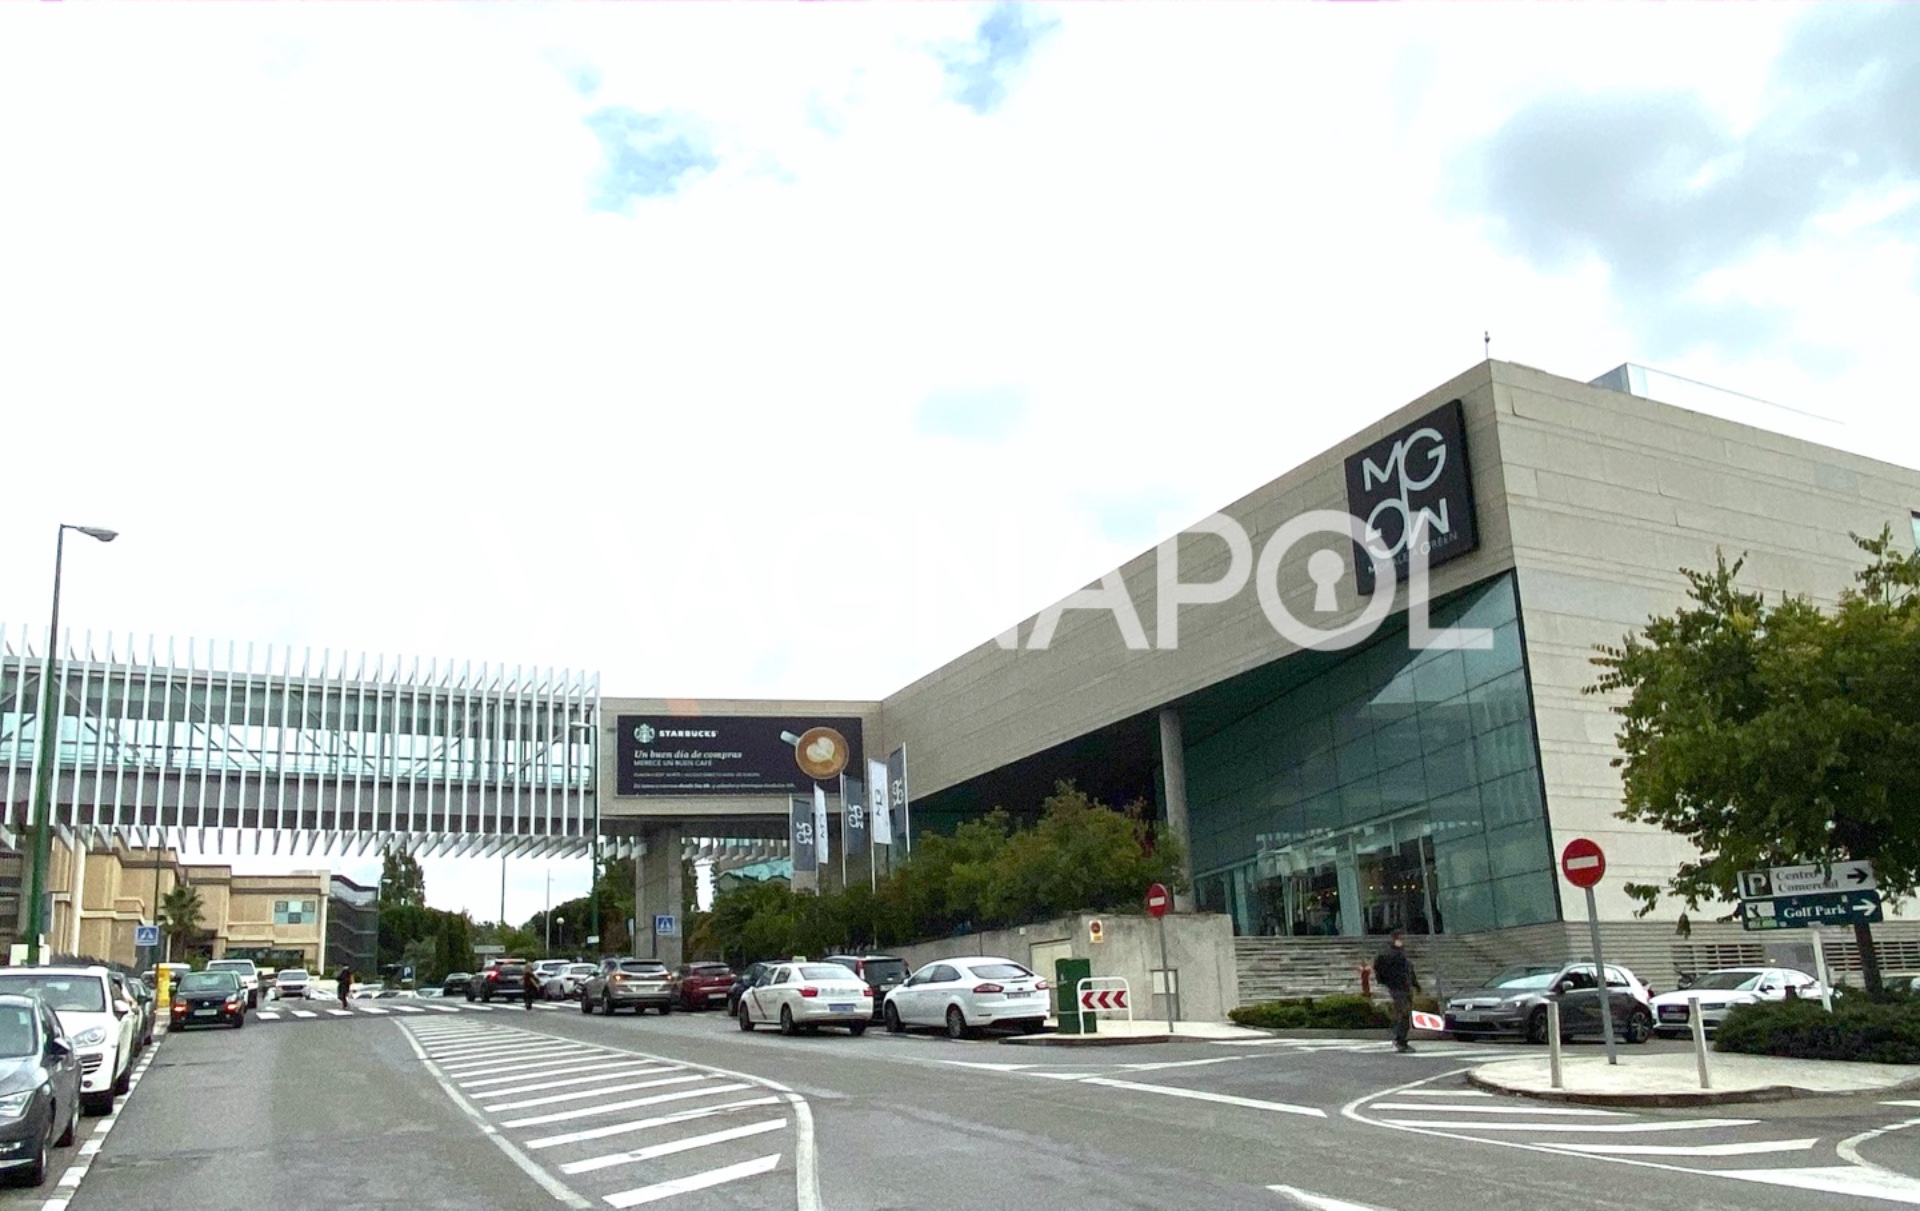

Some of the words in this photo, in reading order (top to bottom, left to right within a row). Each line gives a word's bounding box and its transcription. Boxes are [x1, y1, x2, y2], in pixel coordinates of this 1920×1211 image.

[1420, 530, 1458, 556] GREEN
[659, 730, 717, 738] STARBUCKS
[634, 750, 648, 759] Un
[650, 749, 672, 759] buen
[690, 749, 702, 759] de
[703, 751, 742, 760] compras
[1776, 869, 1819, 880] Centro
[1778, 879, 1839, 892] Comercal
[1783, 905, 1812, 919] Golf
[1815, 904, 1846, 916] Park
